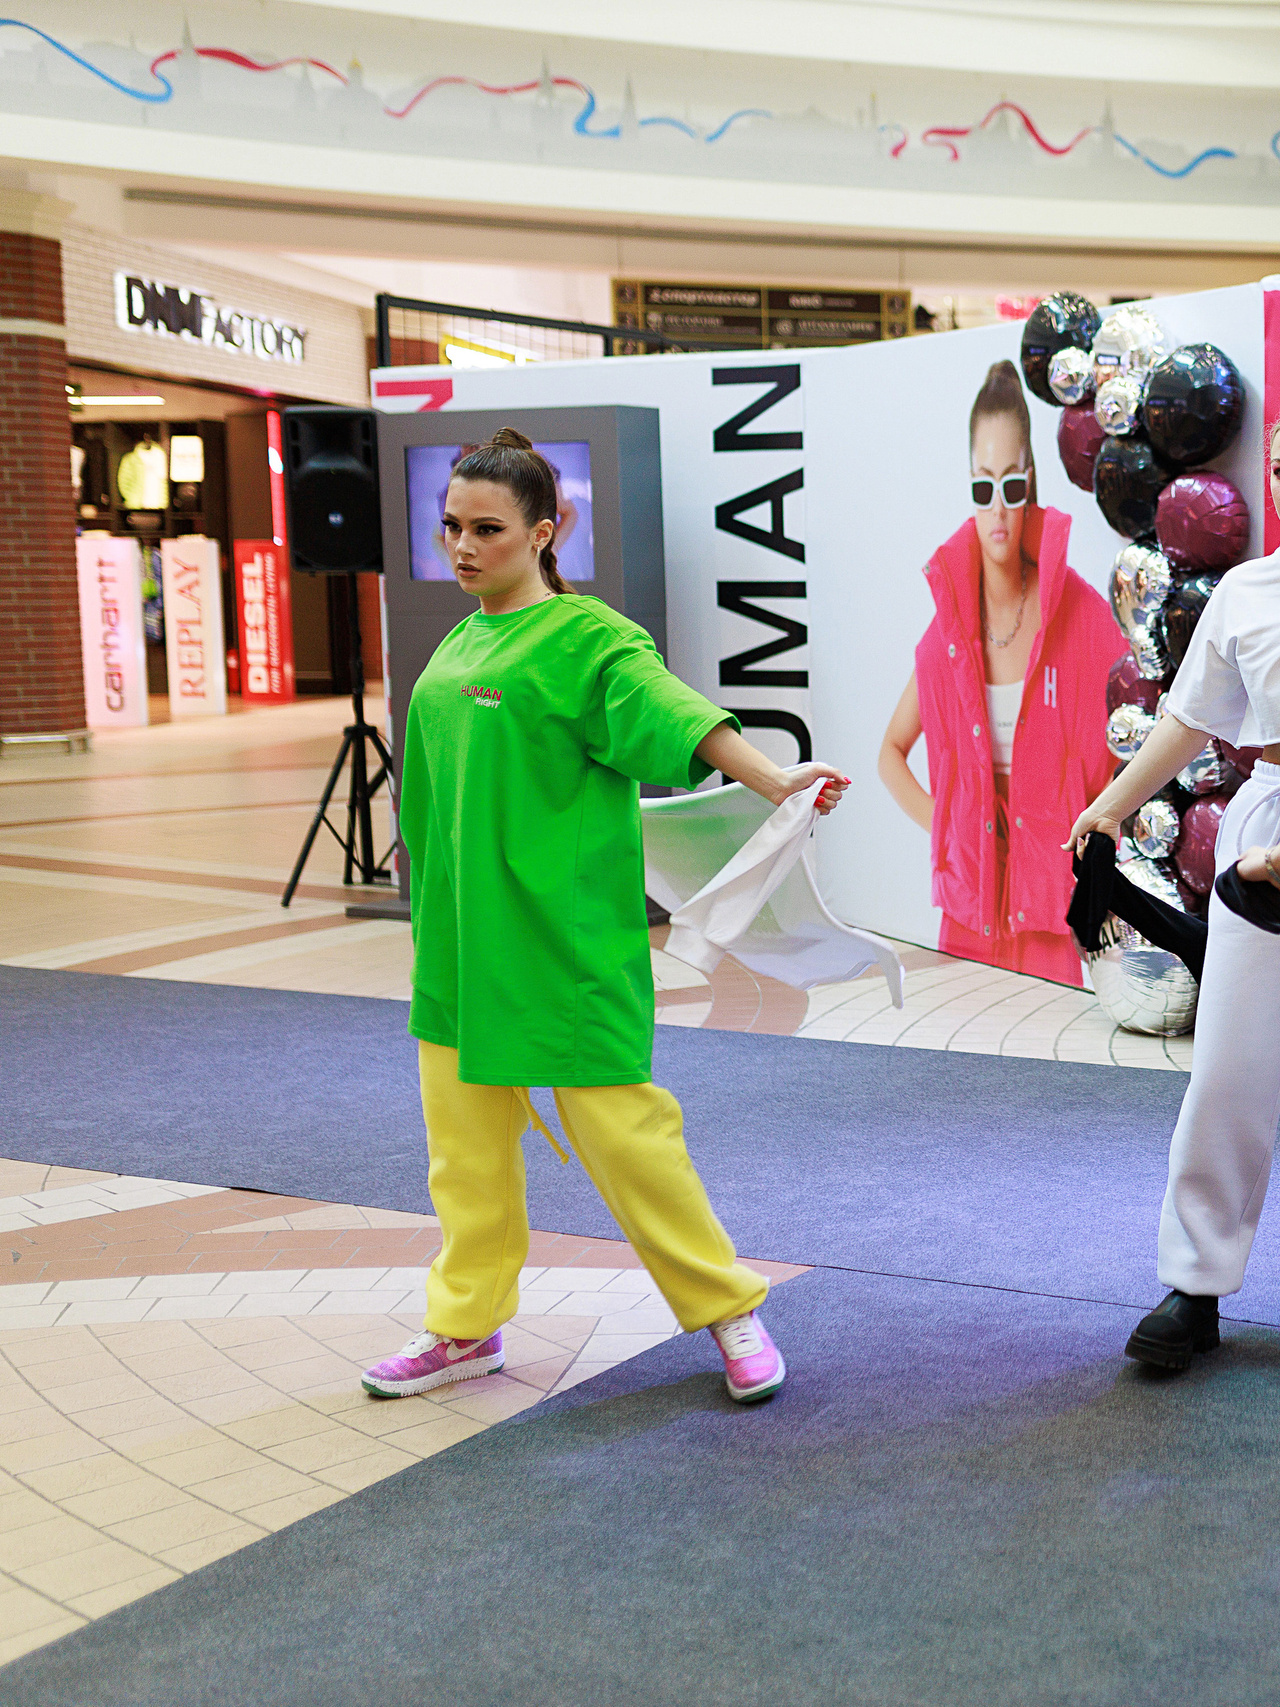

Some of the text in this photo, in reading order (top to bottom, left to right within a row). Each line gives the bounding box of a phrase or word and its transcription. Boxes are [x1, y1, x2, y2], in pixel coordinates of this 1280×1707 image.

[97, 556, 124, 713] carhartt
[172, 556, 206, 699] REPLAY
[242, 551, 271, 694] DIESEL
[711, 363, 813, 786] UMAN
[460, 685, 503, 701] HUMAN
[475, 697, 501, 709] RIGHT
